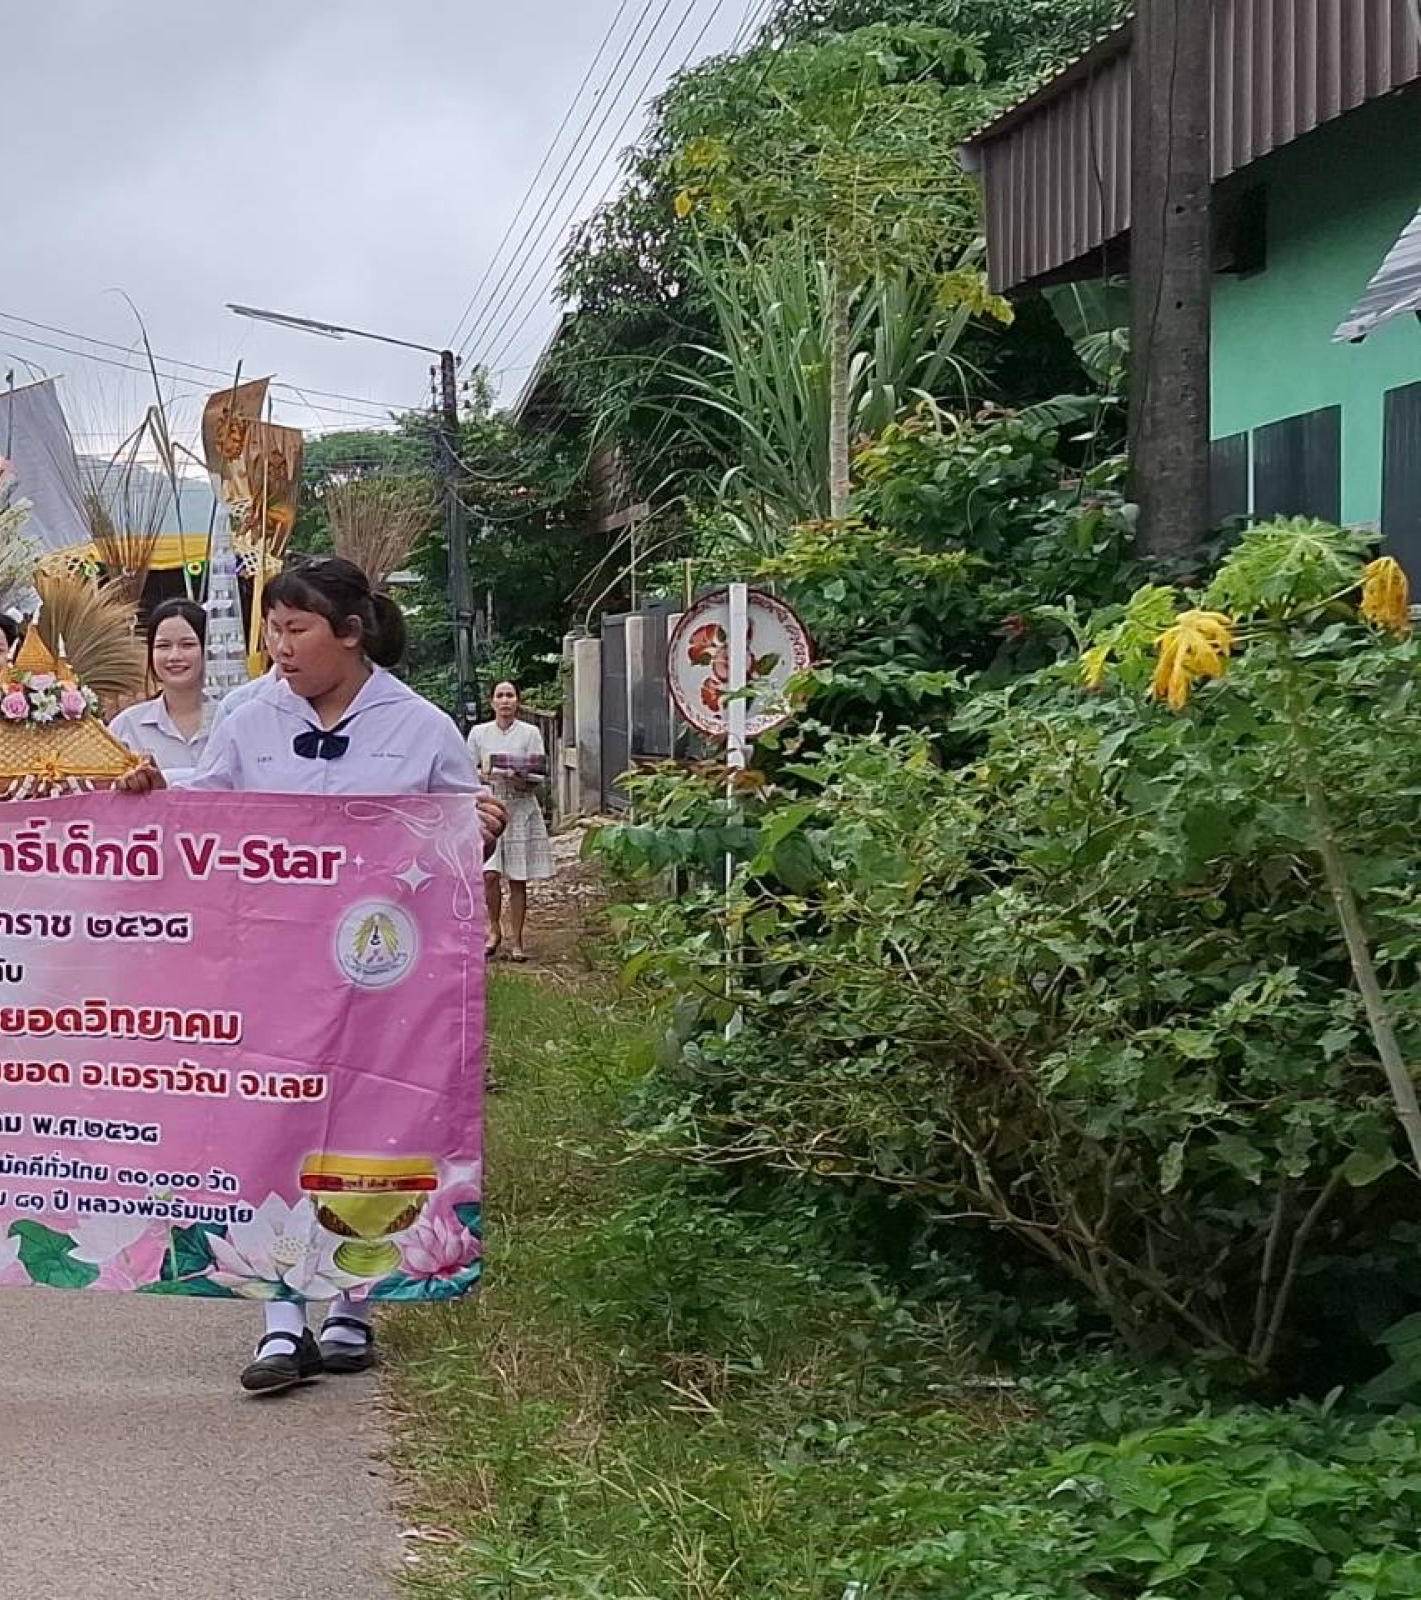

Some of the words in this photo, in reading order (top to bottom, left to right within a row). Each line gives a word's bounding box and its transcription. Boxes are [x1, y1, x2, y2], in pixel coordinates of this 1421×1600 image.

[180, 837, 342, 879] V-Star
[87, 915, 189, 938] ๒๕๖๘
[82, 1062, 227, 1094] อ.เอราวัณ
[240, 1074, 324, 1099] จ.เลย
[208, 1168, 237, 1191] วัด
[53, 1190, 69, 1211] ปี
